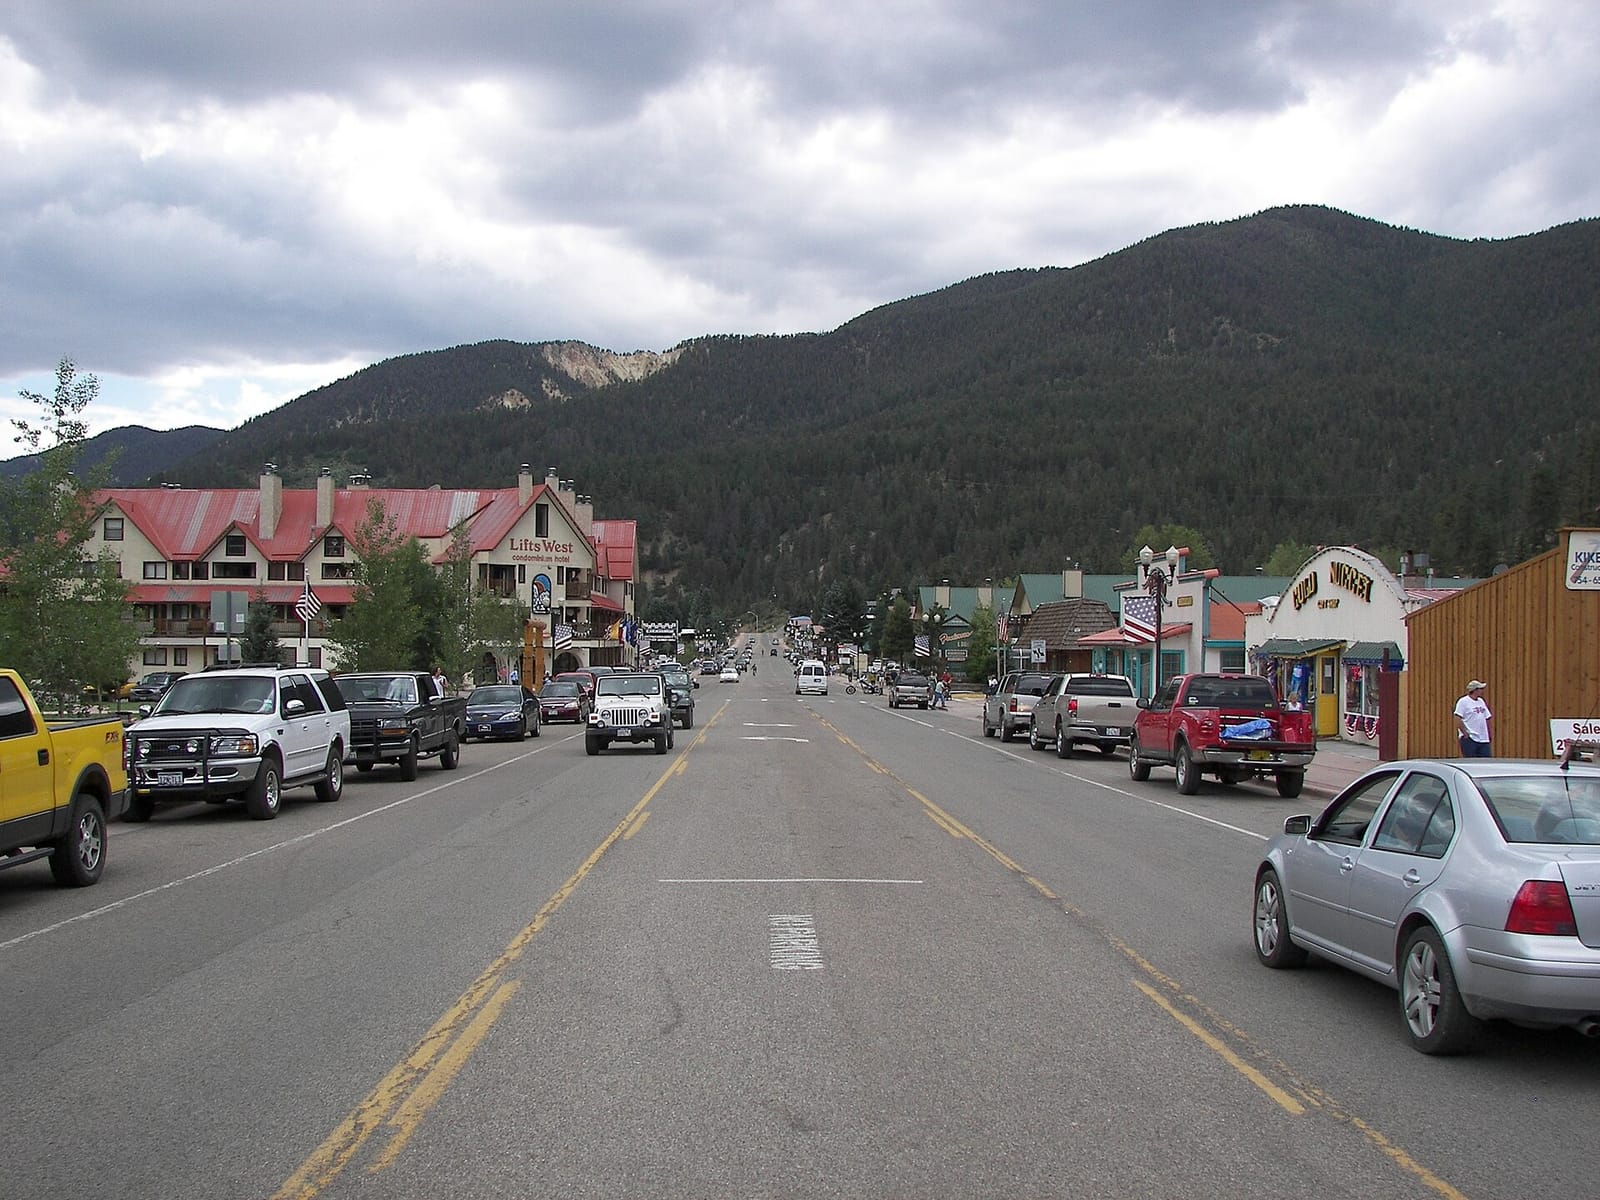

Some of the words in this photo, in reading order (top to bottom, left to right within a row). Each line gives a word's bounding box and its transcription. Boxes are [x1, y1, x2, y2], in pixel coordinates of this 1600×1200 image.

[510, 538, 541, 553] Lifts
[542, 539, 574, 554] West
[512, 554, 553, 563] condominium
[554, 555, 570, 563] hotel
